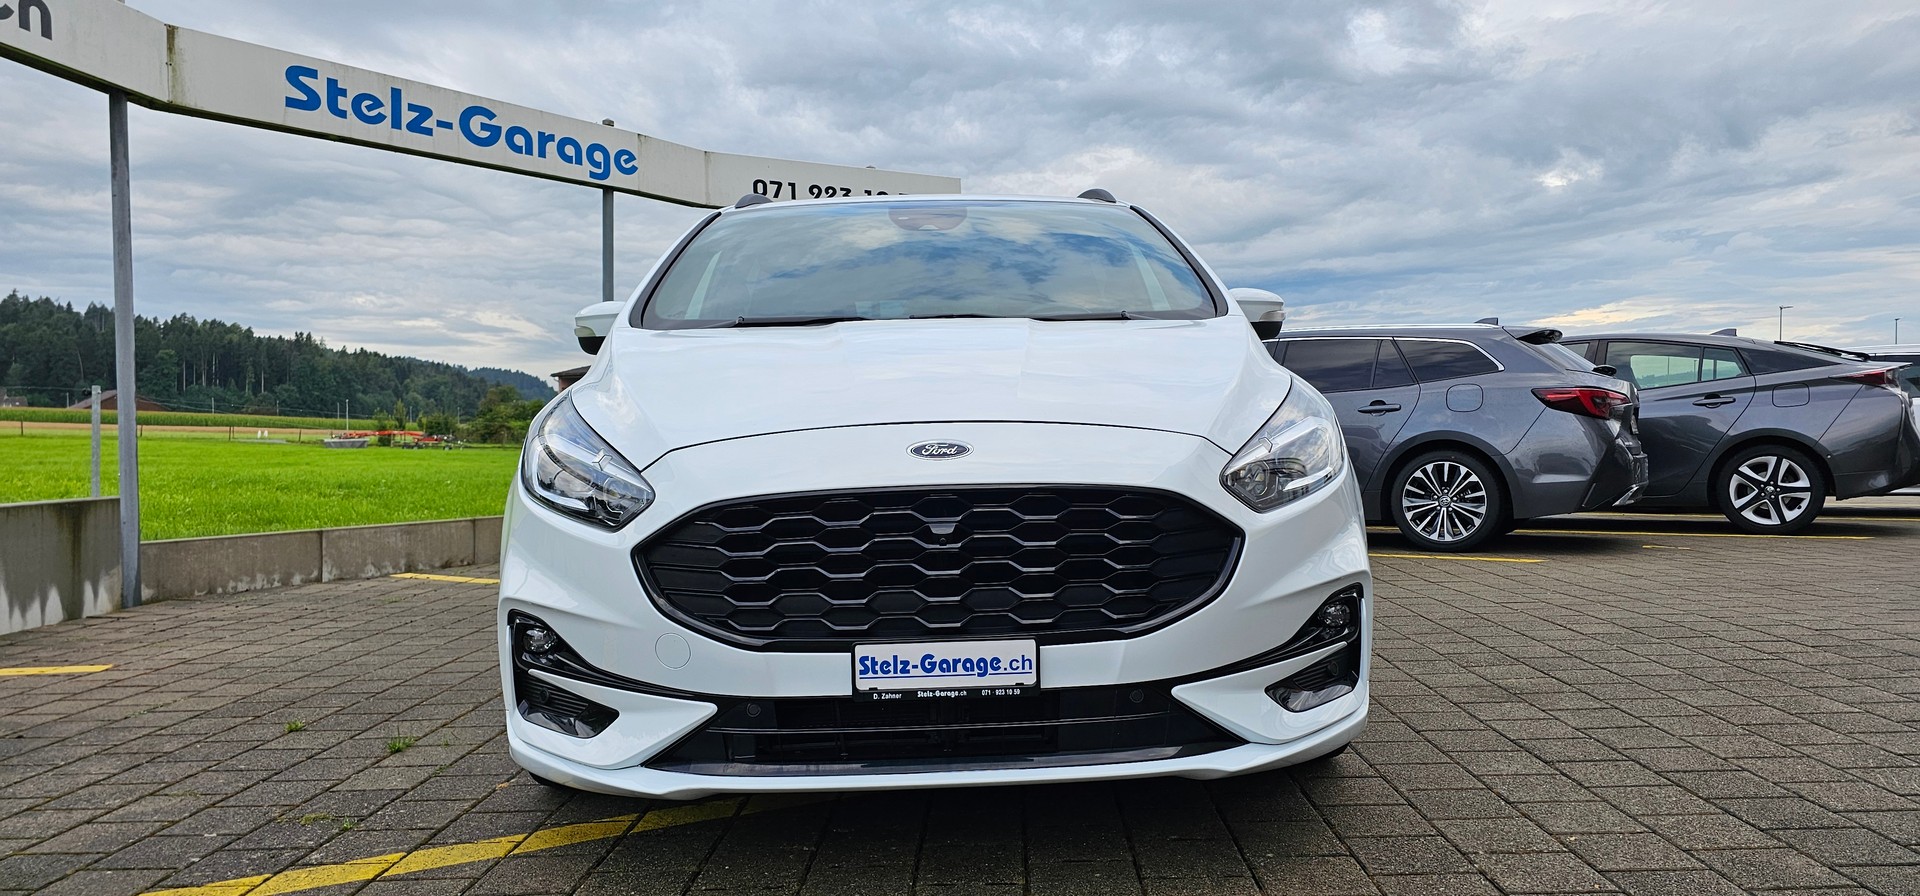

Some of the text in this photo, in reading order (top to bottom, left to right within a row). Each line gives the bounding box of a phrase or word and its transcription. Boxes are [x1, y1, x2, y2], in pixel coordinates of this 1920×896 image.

[284, 65, 639, 181] Stelz-Garage
[752, 179, 797, 200] 071
[921, 443, 958, 455] Ford
[858, 653, 1033, 678] Stelz-Garage.ch
[917, 690, 968, 698] Stelz-Garage.ch
